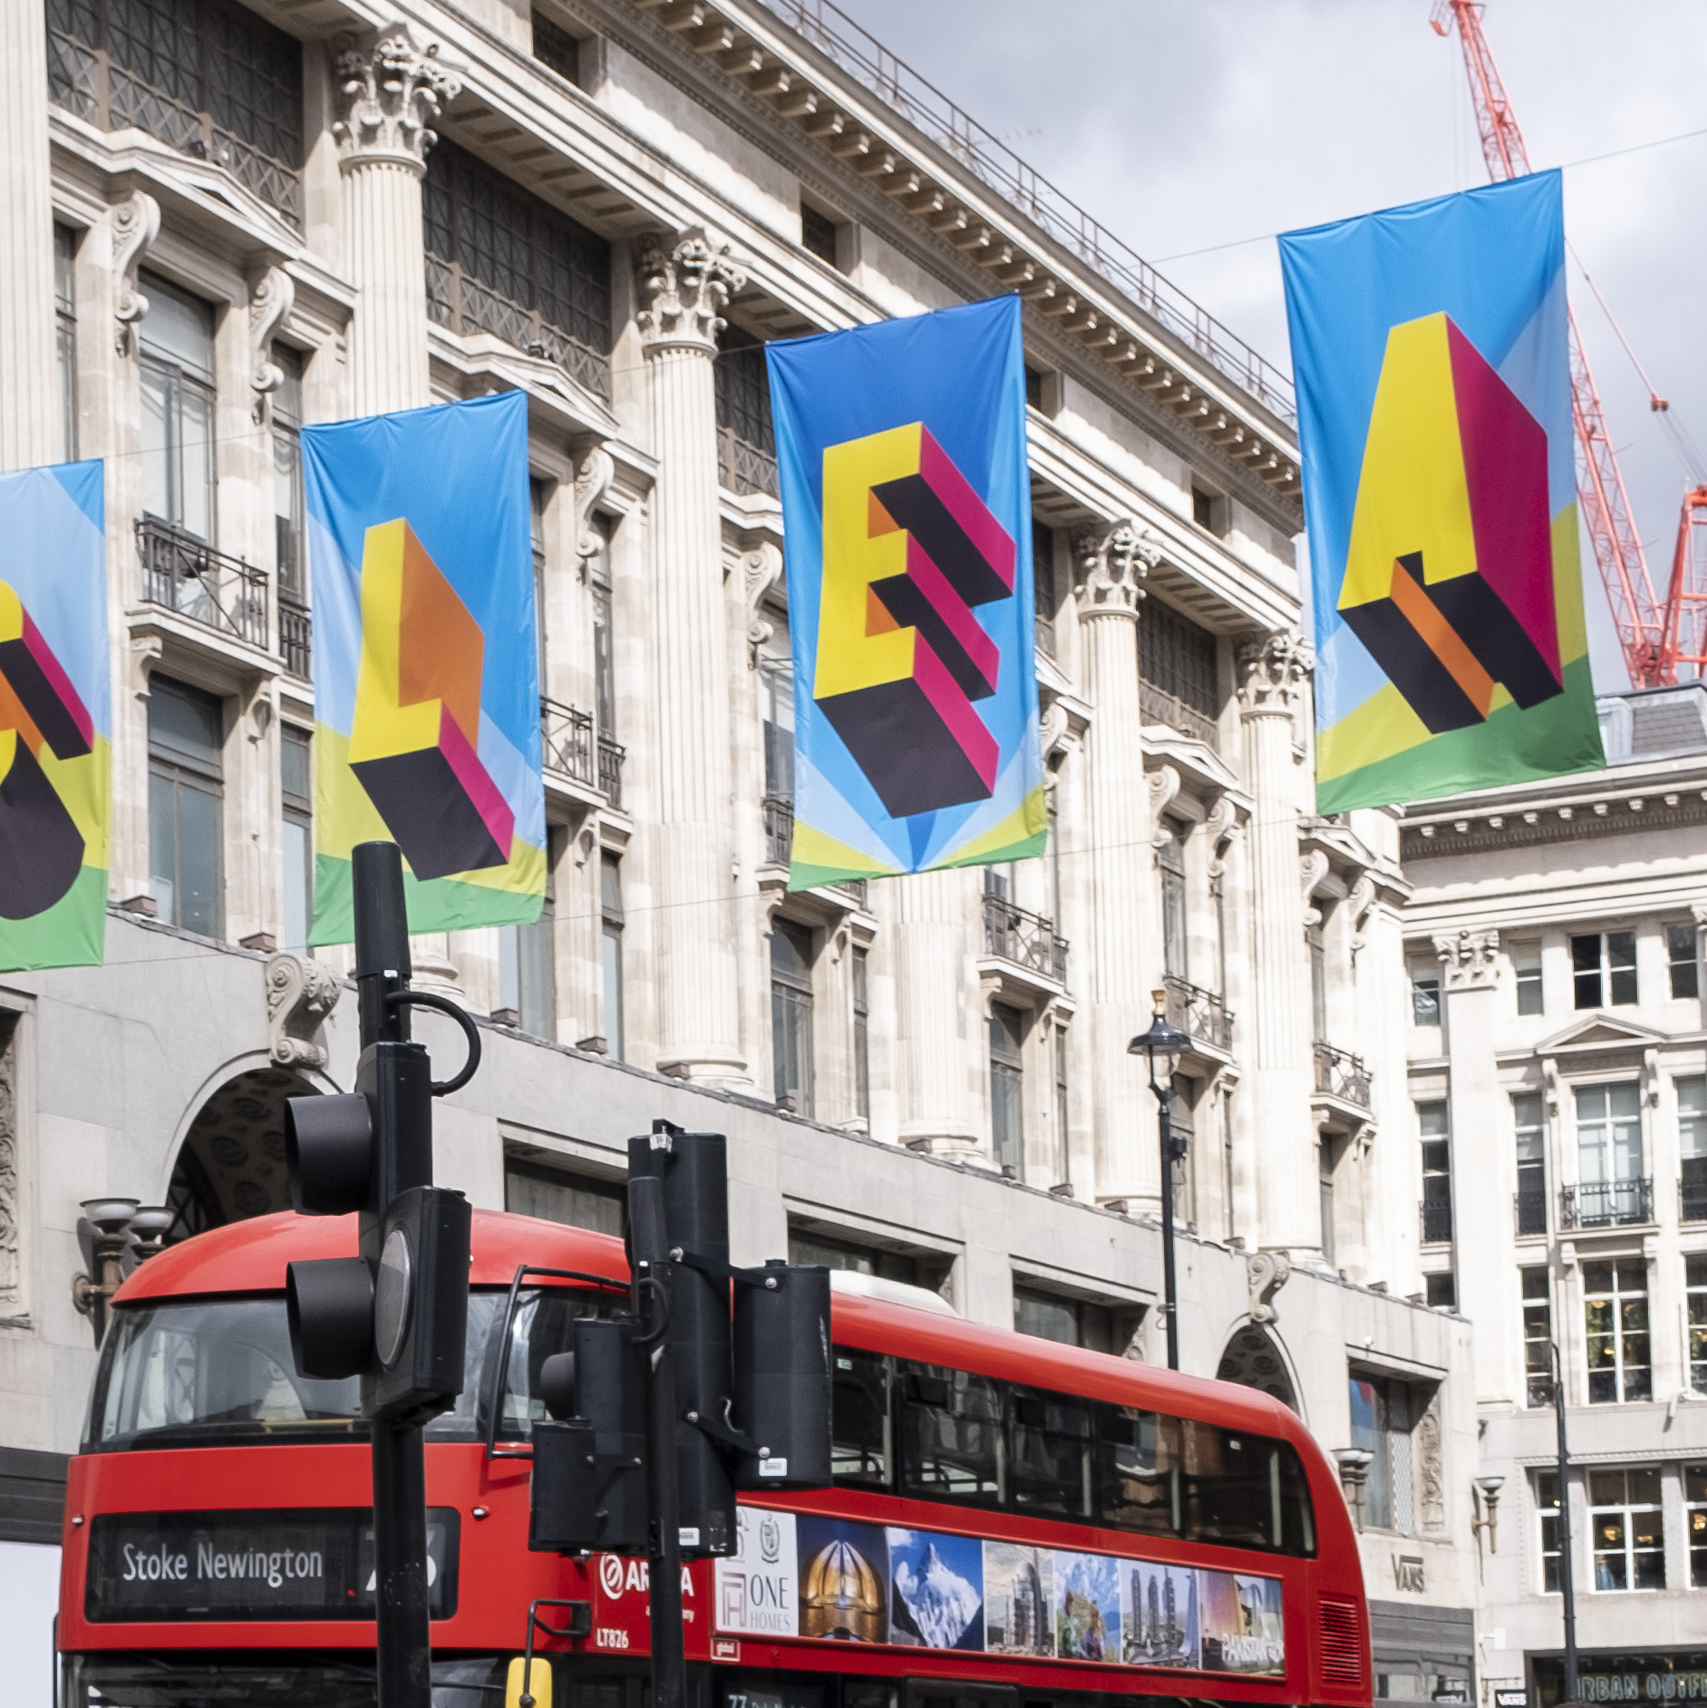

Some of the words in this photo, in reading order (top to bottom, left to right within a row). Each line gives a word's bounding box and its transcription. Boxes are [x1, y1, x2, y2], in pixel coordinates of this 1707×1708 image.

[122, 1542, 188, 1581] Stoke
[196, 1543, 324, 1589] Newington
[624, 1560, 696, 1598] ARA
[1391, 1553, 1425, 1595] VANS
[750, 1574, 791, 1610] ONE
[596, 1626, 630, 1650] LT826
[750, 1612, 791, 1632] HOMES
[1576, 1673, 1639, 1701] RBAN
